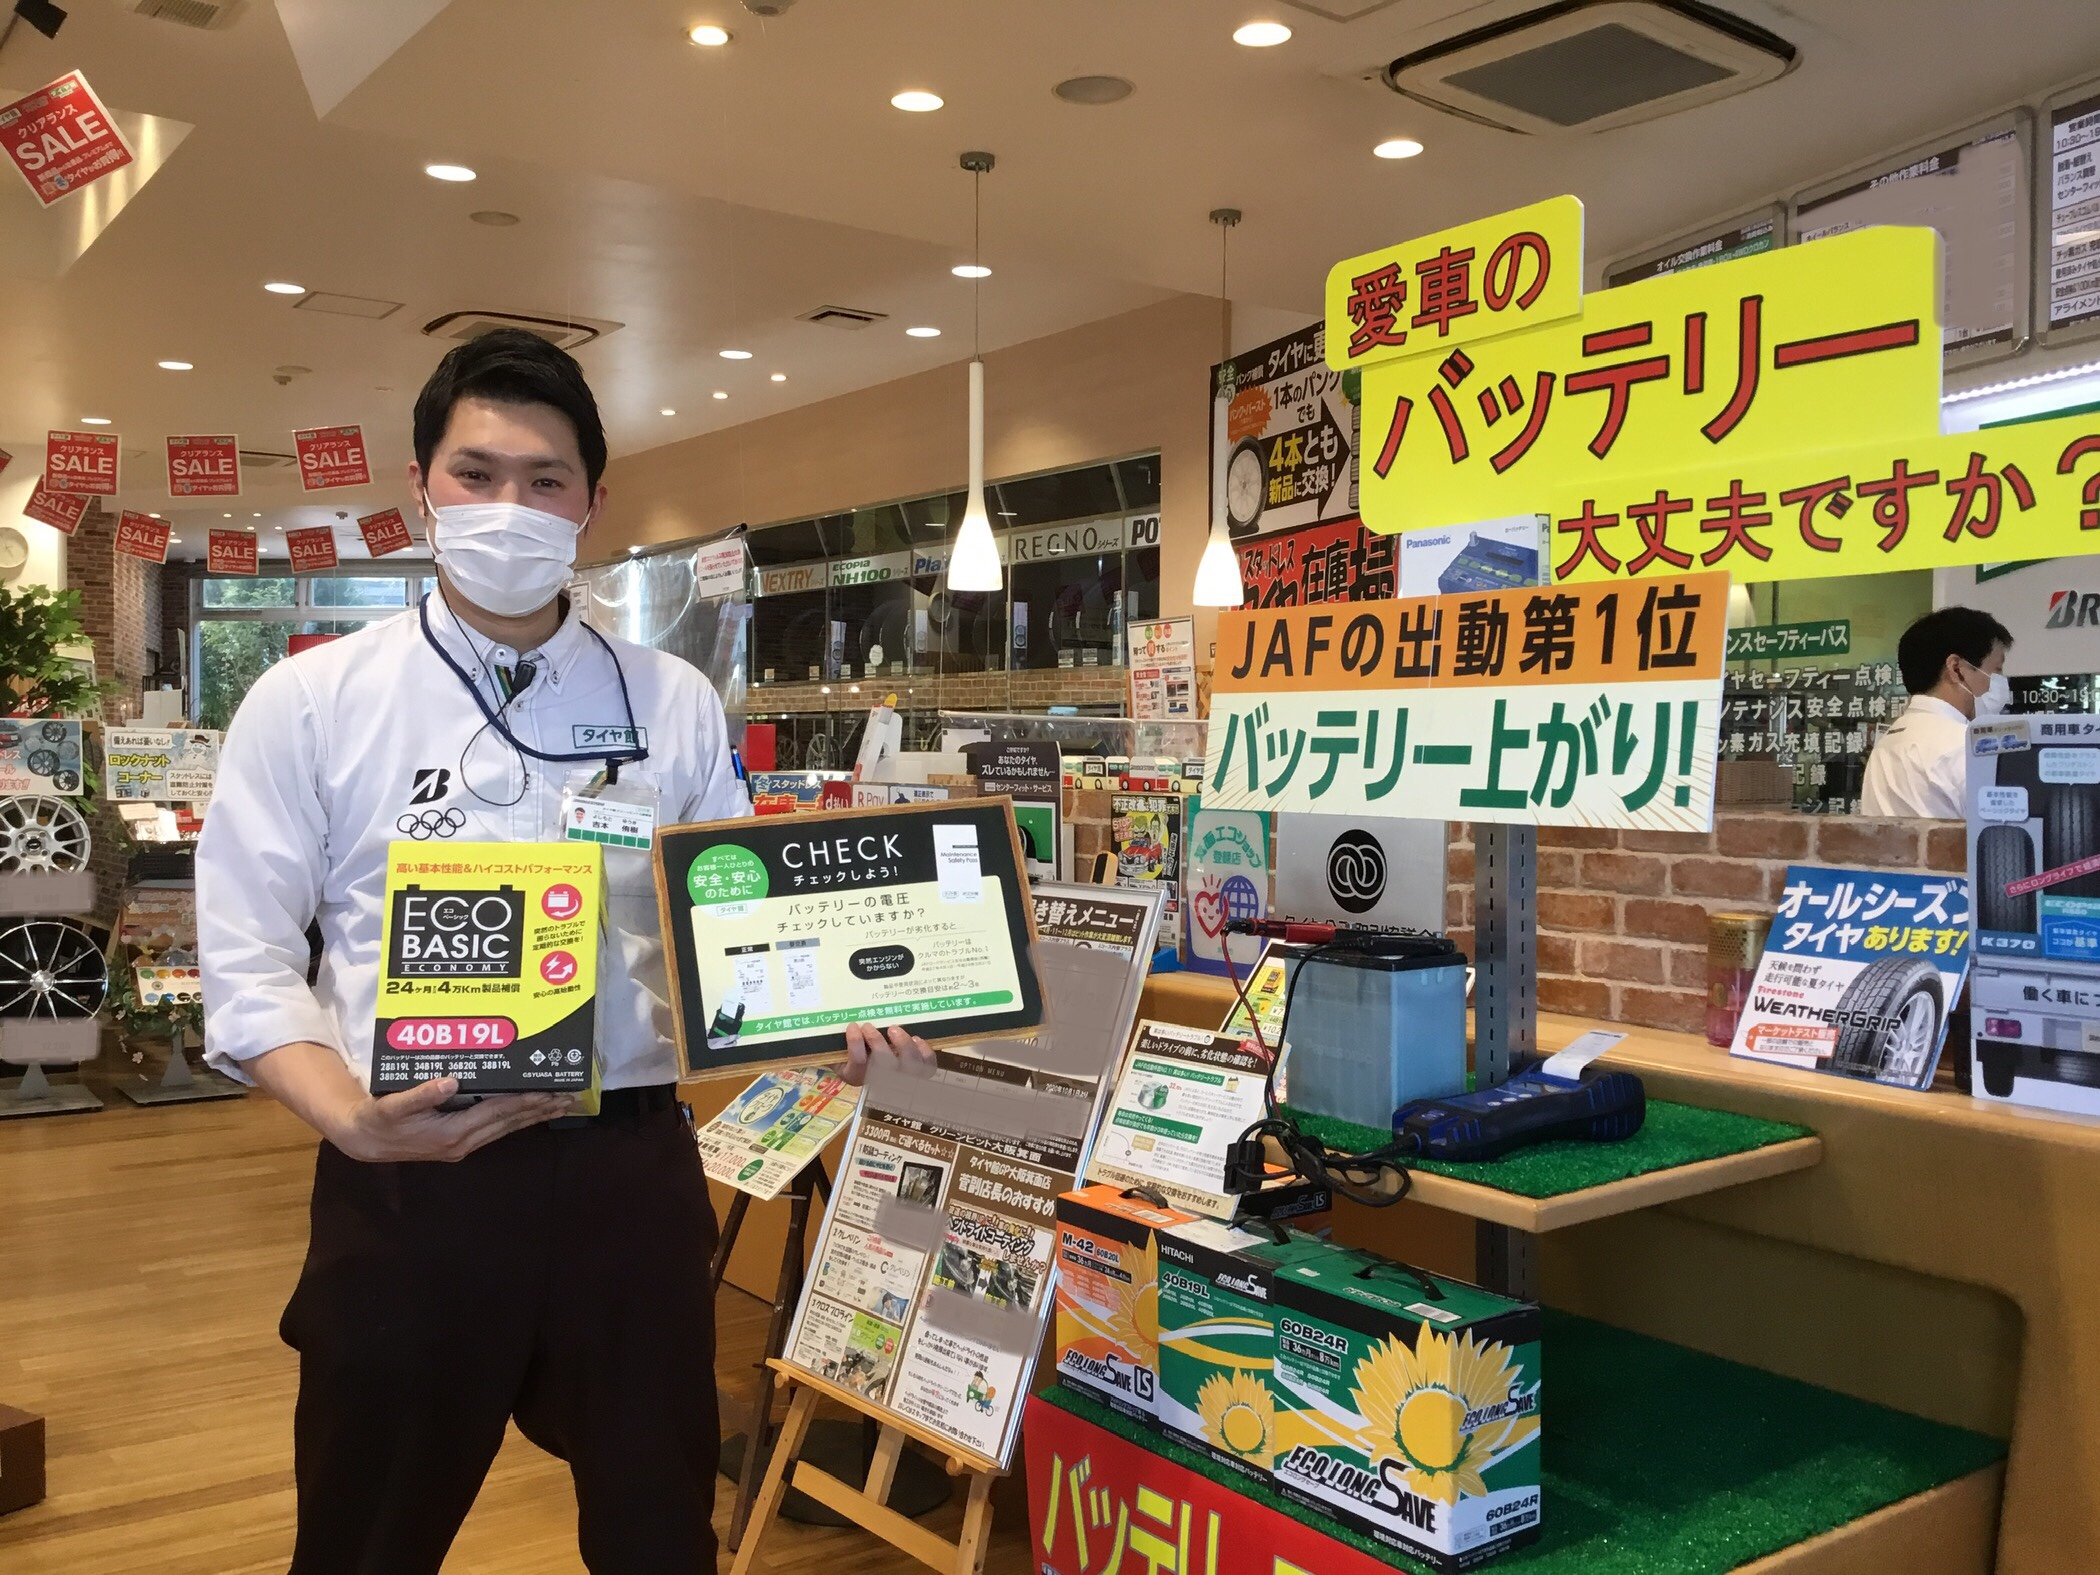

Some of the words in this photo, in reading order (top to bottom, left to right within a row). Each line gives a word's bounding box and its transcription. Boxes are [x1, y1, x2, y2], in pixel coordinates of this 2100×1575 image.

[18, 104, 78, 139] クリアランス
[16, 110, 109, 170] SALE
[1347, 231, 1551, 357] 愛車の
[1273, 371, 1341, 410] 1本のパンク
[1373, 294, 1920, 480] バッテリー
[1297, 403, 1315, 423] でも
[60, 445, 104, 455] クリアランス
[309, 440, 350, 451] クリアランス
[1269, 425, 1338, 472] 4本とも
[50, 453, 113, 475] SALE
[172, 458, 234, 476] SALE
[302, 447, 363, 470] SALE
[1269, 462, 1336, 504] 新品に交換!
[33, 491, 80, 520] SALE
[1555, 436, 2100, 581] 大丈夫ですか?
[120, 526, 165, 549] SALE
[366, 522, 406, 544] SALE
[1131, 516, 1160, 546] PO
[1406, 535, 1450, 549] Panasonic
[211, 545, 254, 560] SALE
[292, 542, 333, 558] SALE
[1015, 527, 1098, 561] REGNO
[1244, 539, 1295, 578] スタッドレス
[832, 567, 892, 585] NH100
[1231, 583, 1701, 680] JAFの出動第1位
[109, 754, 170, 768] ロックナット
[1211, 693, 1698, 814] バッテリー上がり!
[118, 770, 163, 784] コーナー
[772, 779, 822, 790] スタッドレス
[995, 782, 1052, 794] センターフィット・サービス
[712, 854, 737, 862] すべては
[782, 834, 904, 869] CHECK
[1213, 850, 1241, 866] 登録店
[696, 860, 754, 872] お客様一人ひとりの
[793, 866, 900, 887] チェックしよう!
[693, 869, 761, 888] 安全・安心
[705, 885, 753, 899] のために
[403, 896, 512, 932] ECO
[788, 892, 910, 916] バッテリーの電圧
[1032, 899, 1134, 929] き替えメニュー
[776, 907, 925, 934] チェックしていますか?
[401, 934, 510, 959] BASIC
[932, 938, 972, 948] バッテリーは
[1783, 922, 1969, 956] タイヤあります!
[1981, 936, 2036, 950] K370
[404, 963, 507, 972] ECONOMY
[858, 954, 904, 965] 突然エンジンが
[866, 962, 900, 972] かからない
[1768, 960, 1822, 975] 天候を問わず
[1757, 985, 1805, 999] Firestone
[1764, 972, 1845, 992] 走行可能な夏タイヤ
[1754, 995, 1902, 1032] WEATHERGRIP
[396, 1023, 504, 1046] 40B19L
[1757, 1024, 1837, 1040] マーケットテスト販売
[883, 1113, 922, 1132] タイヤ館
[969, 1156, 1053, 1190] タイヤ館GP大阪箕面店
[958, 1173, 1055, 1218] 菅副店長のおすすめ
[1062, 1231, 1096, 1253] M-42
[1002, 1250, 1047, 1275] しませんか?
[1161, 1244, 1194, 1264] HITACHI
[1162, 1273, 1210, 1299] 40B19L
[1280, 1318, 1349, 1354] 60B24R
[1043, 1451, 1317, 1575] バッテリ
[1486, 1493, 1539, 1522] 60B24R
